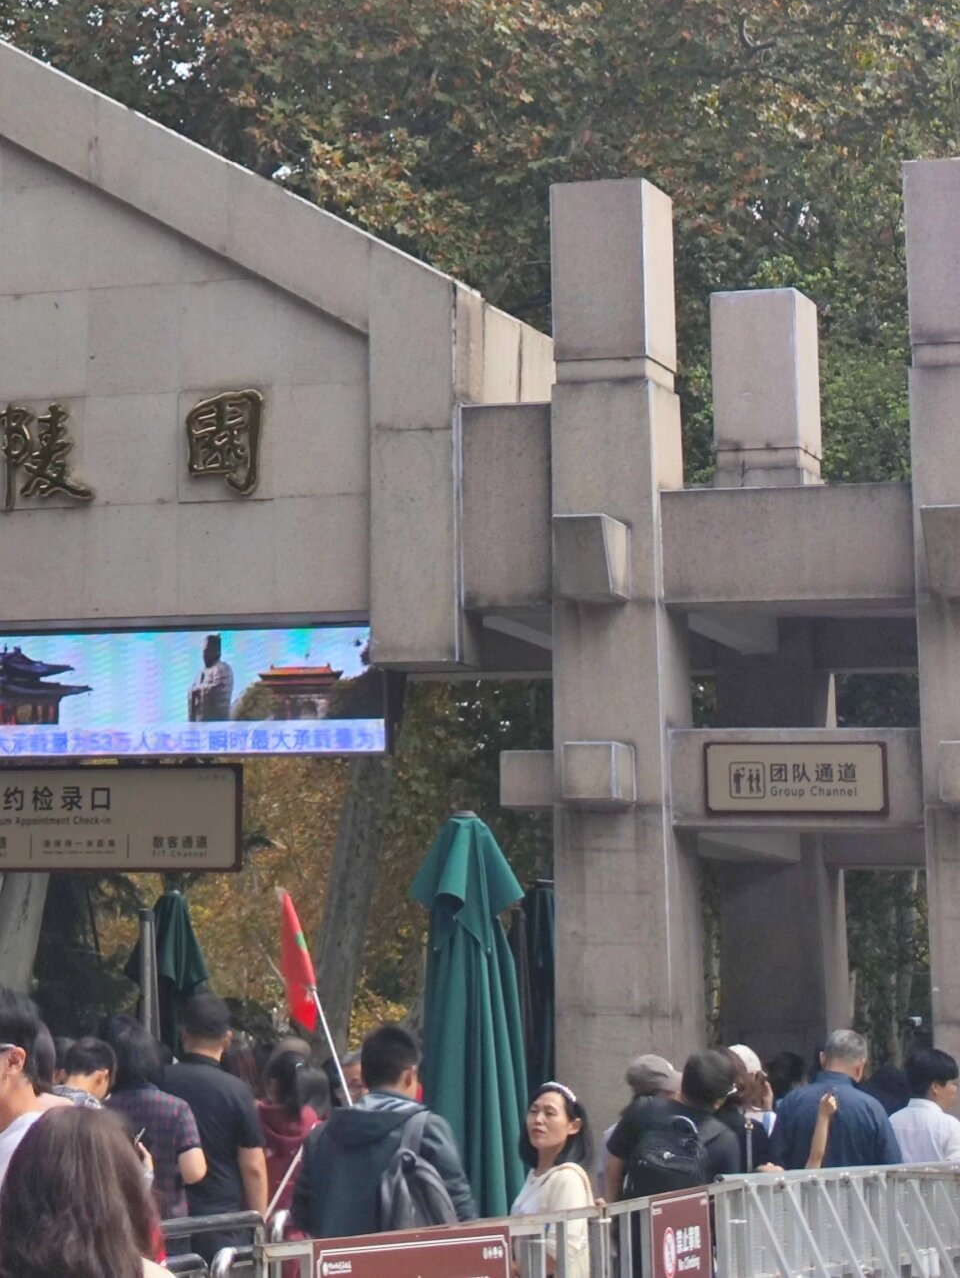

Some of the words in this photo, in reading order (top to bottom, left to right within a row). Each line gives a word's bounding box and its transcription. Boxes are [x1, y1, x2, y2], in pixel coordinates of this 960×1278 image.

[770, 762, 857, 783] 团队通道
[770, 786, 805, 798] Group
[810, 785, 857, 797] Channel
[15, 816, 70, 827] Appointment
[73, 815, 111, 825] Check-in
[152, 835, 208, 849] 散客通道
